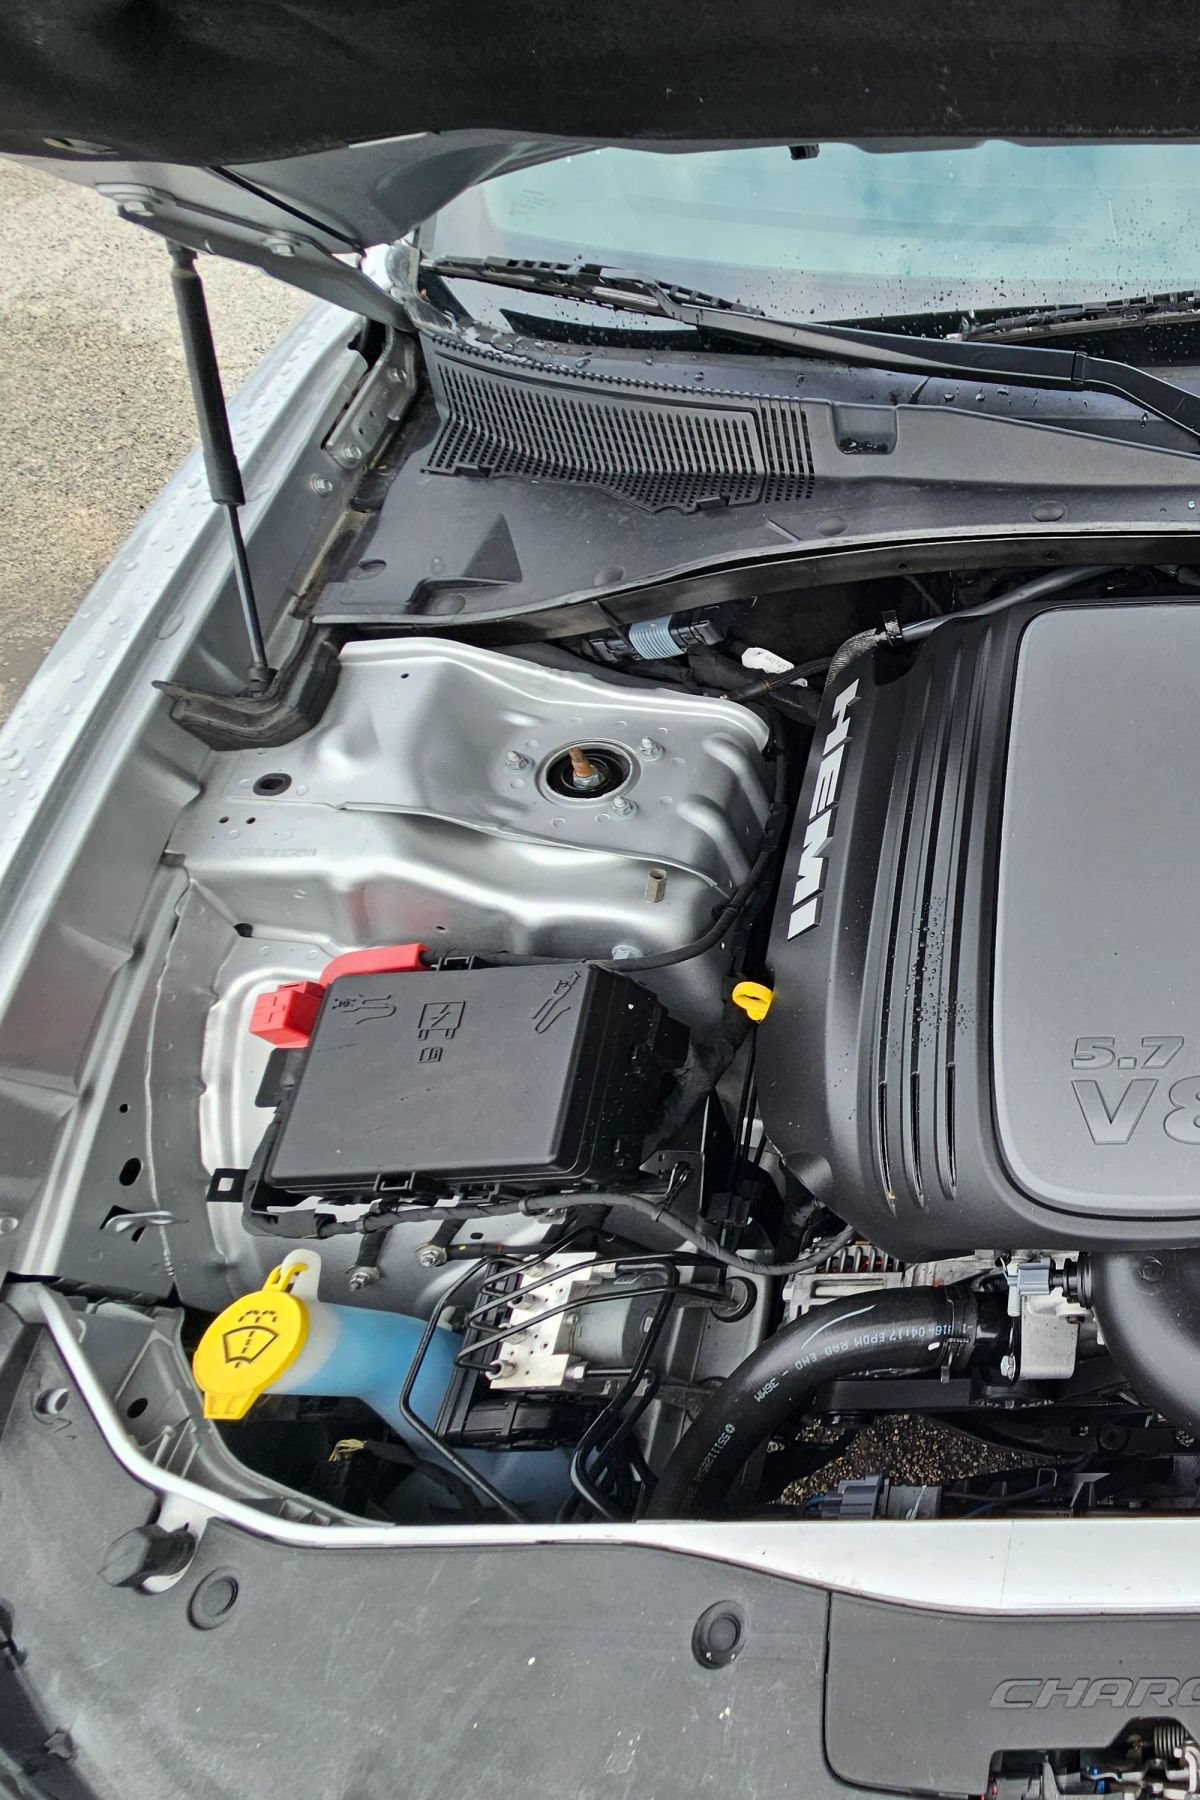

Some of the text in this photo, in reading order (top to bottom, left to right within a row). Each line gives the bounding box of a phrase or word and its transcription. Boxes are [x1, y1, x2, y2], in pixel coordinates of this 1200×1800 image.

[787, 678, 860, 941] HEMI
[824, 1339, 849, 1356] RAD
[853, 1331, 885, 1347] EPDM
[794, 1351, 818, 1370] END
[753, 1377, 780, 1403] 36MM
